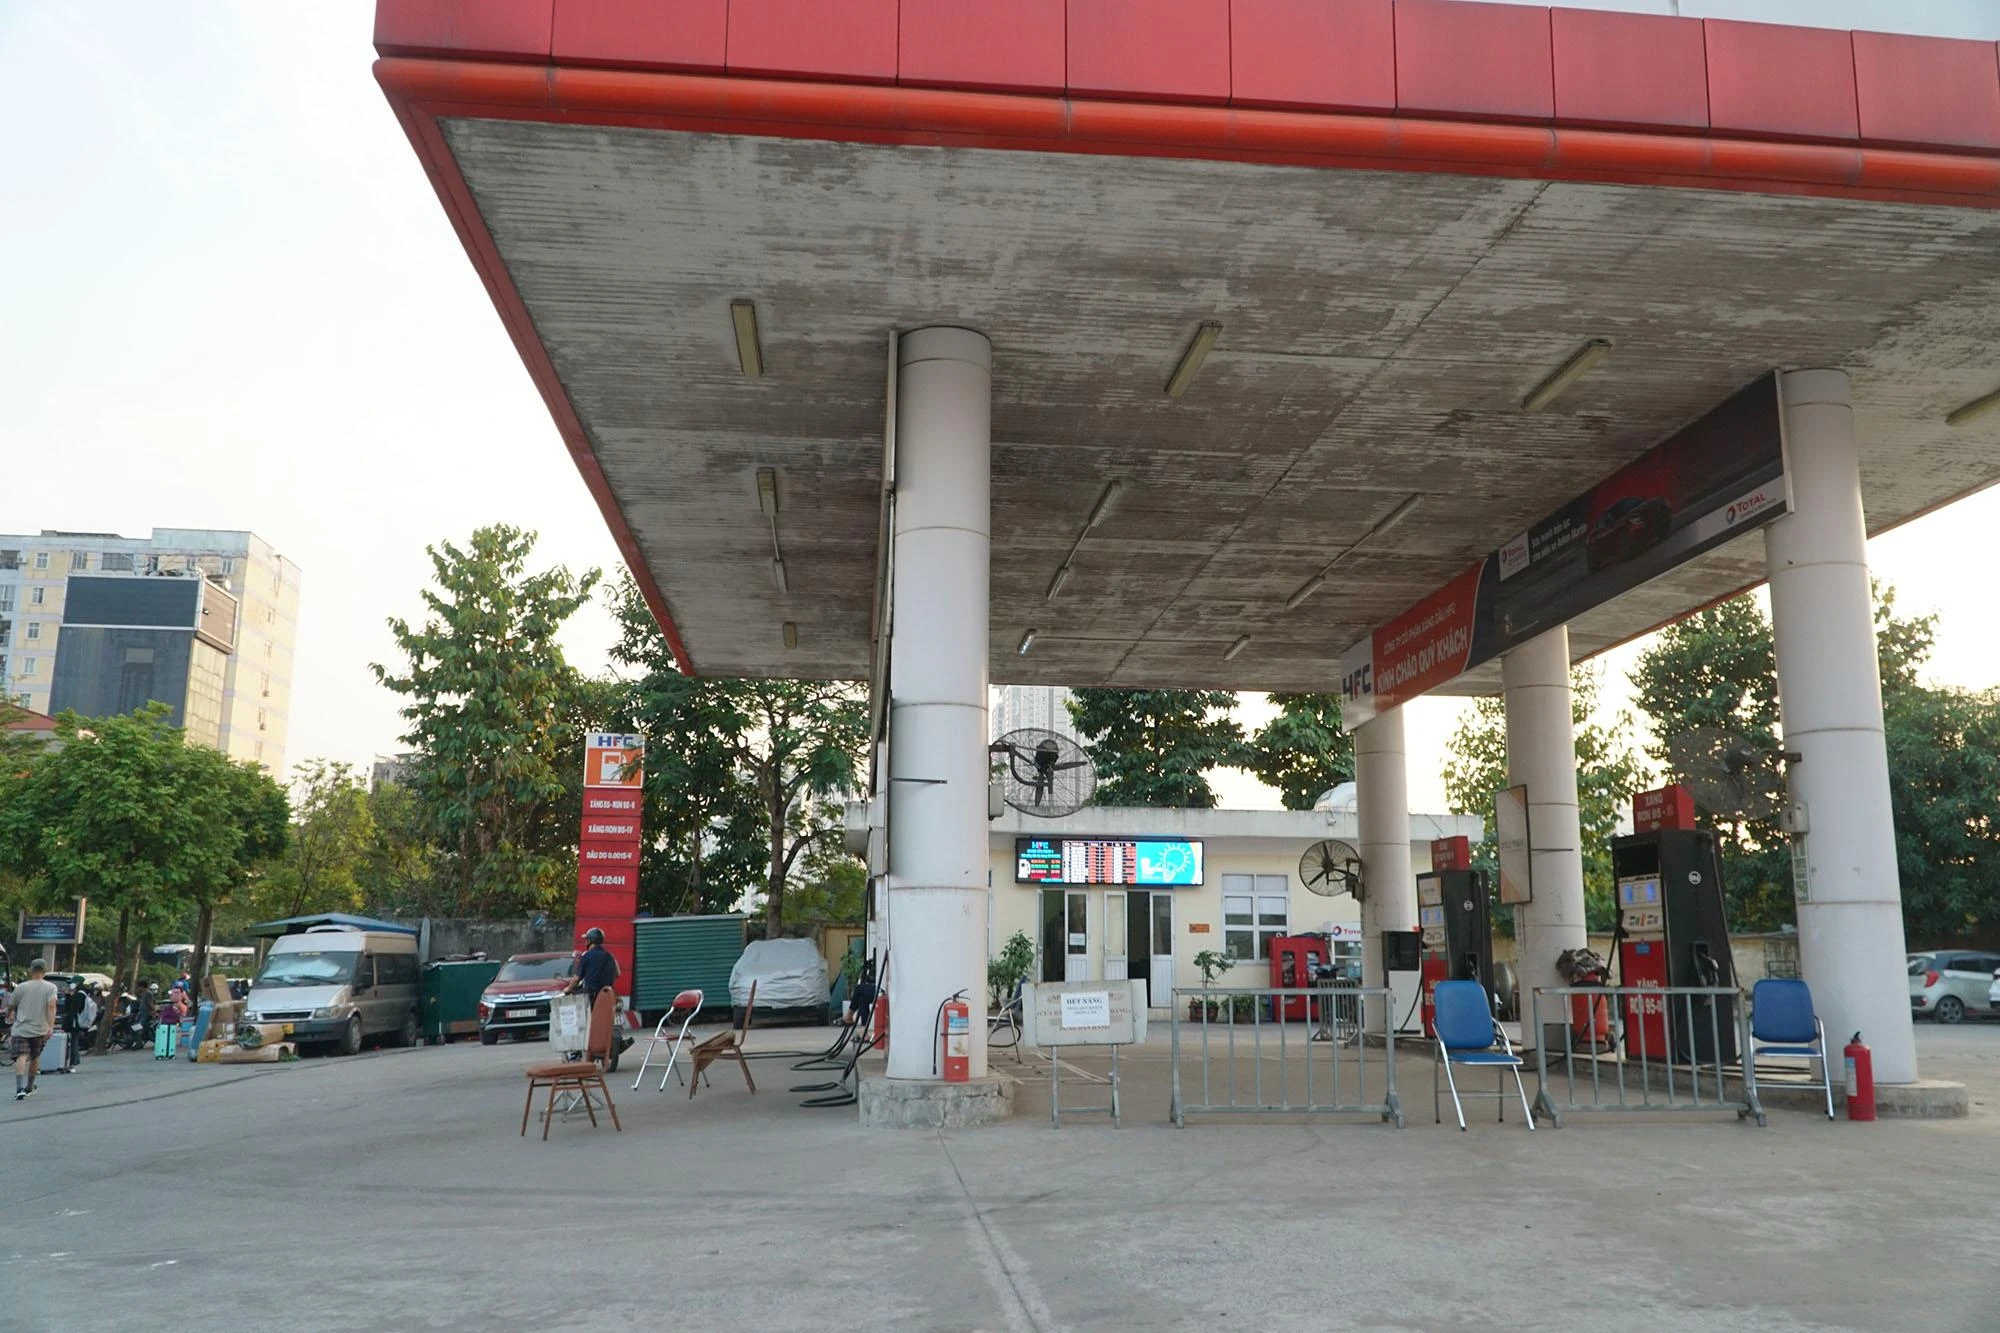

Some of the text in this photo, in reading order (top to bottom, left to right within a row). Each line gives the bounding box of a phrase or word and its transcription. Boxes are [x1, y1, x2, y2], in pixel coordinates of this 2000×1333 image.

[1736, 493, 1766, 512] TOTAL
[1376, 625, 1468, 694] KÍNH CHÀO QUÝ KHÁCH
[1342, 663, 1371, 701] HFC
[590, 875, 625, 885] 24/24H
